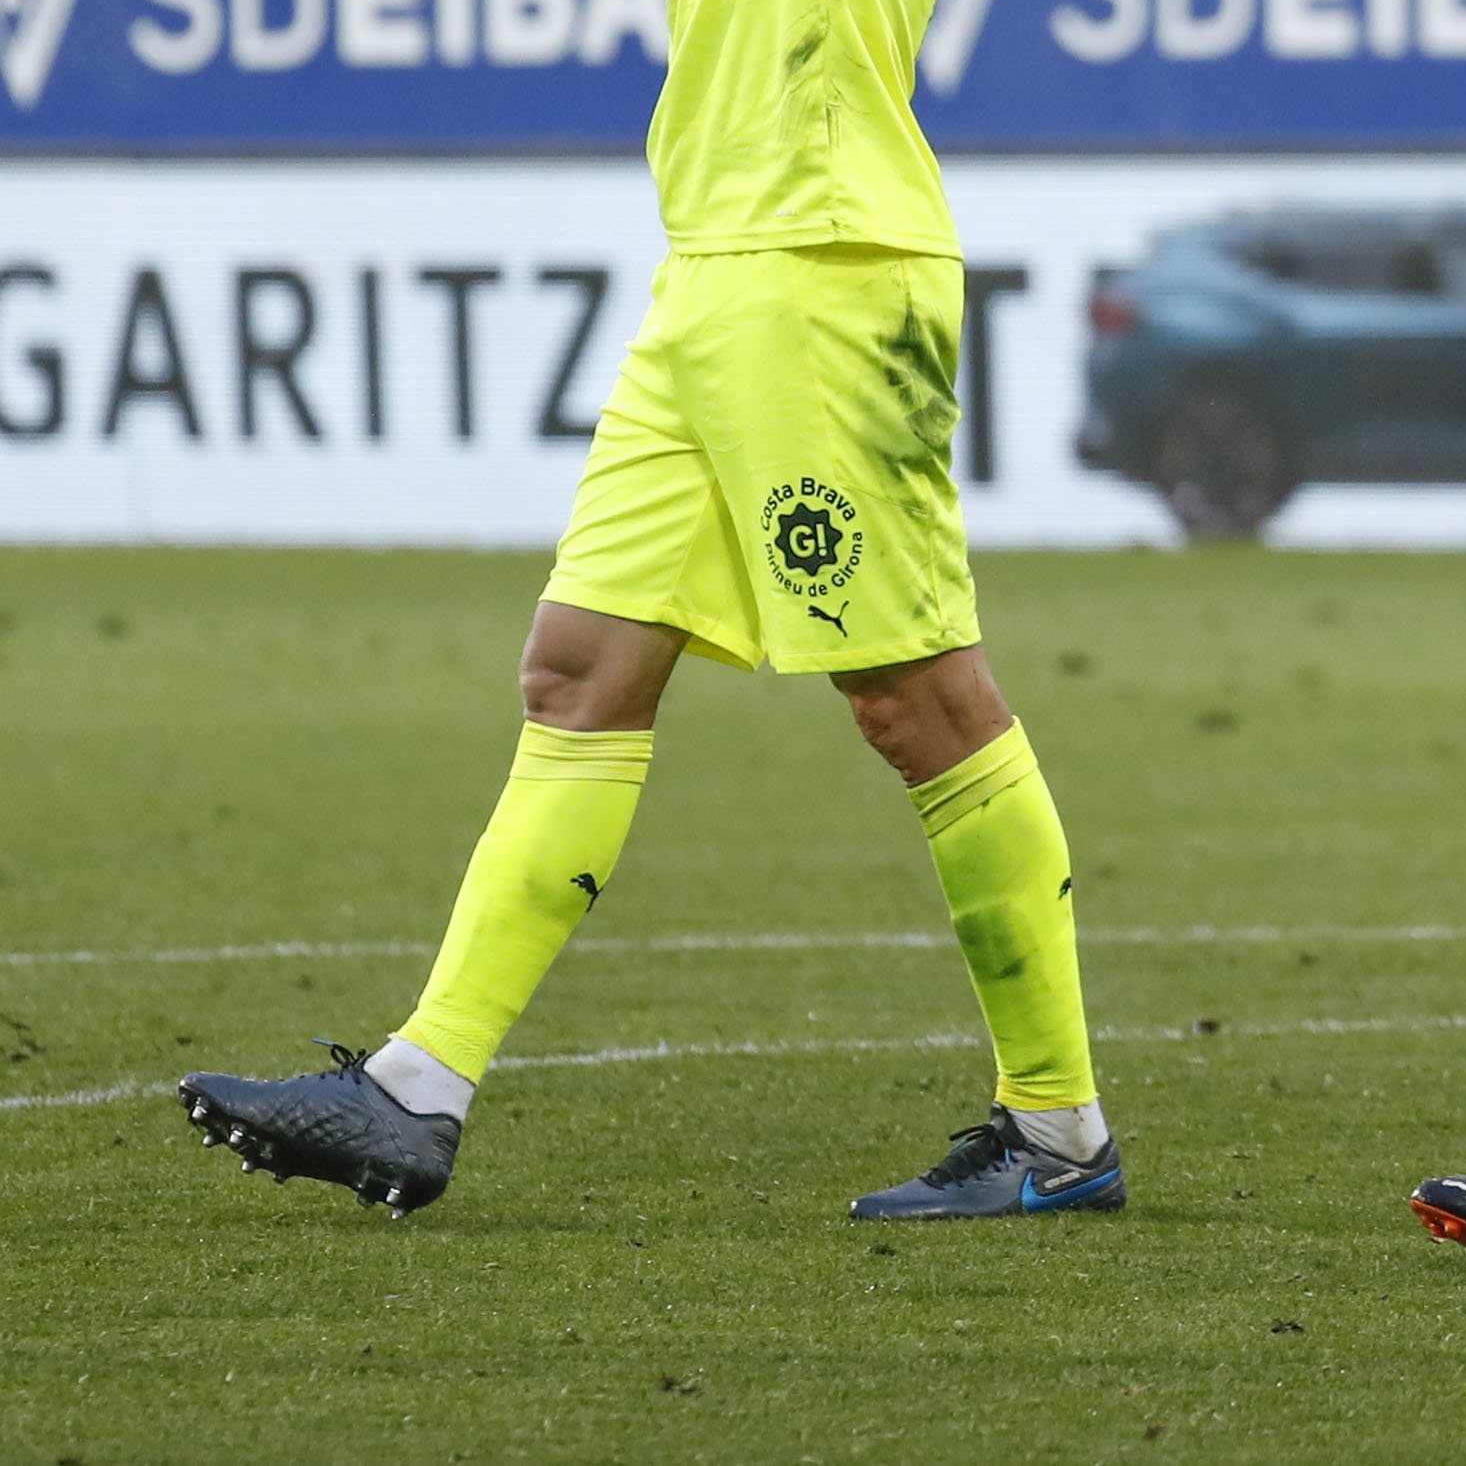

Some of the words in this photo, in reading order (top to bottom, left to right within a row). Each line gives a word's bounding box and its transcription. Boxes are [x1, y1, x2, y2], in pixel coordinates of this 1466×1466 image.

[760, 483, 795, 532] Costa
[801, 477, 856, 522] Brava
[765, 543, 802, 596] Pirineu
[808, 583, 828, 598] de
[831, 531, 863, 588] Girona
